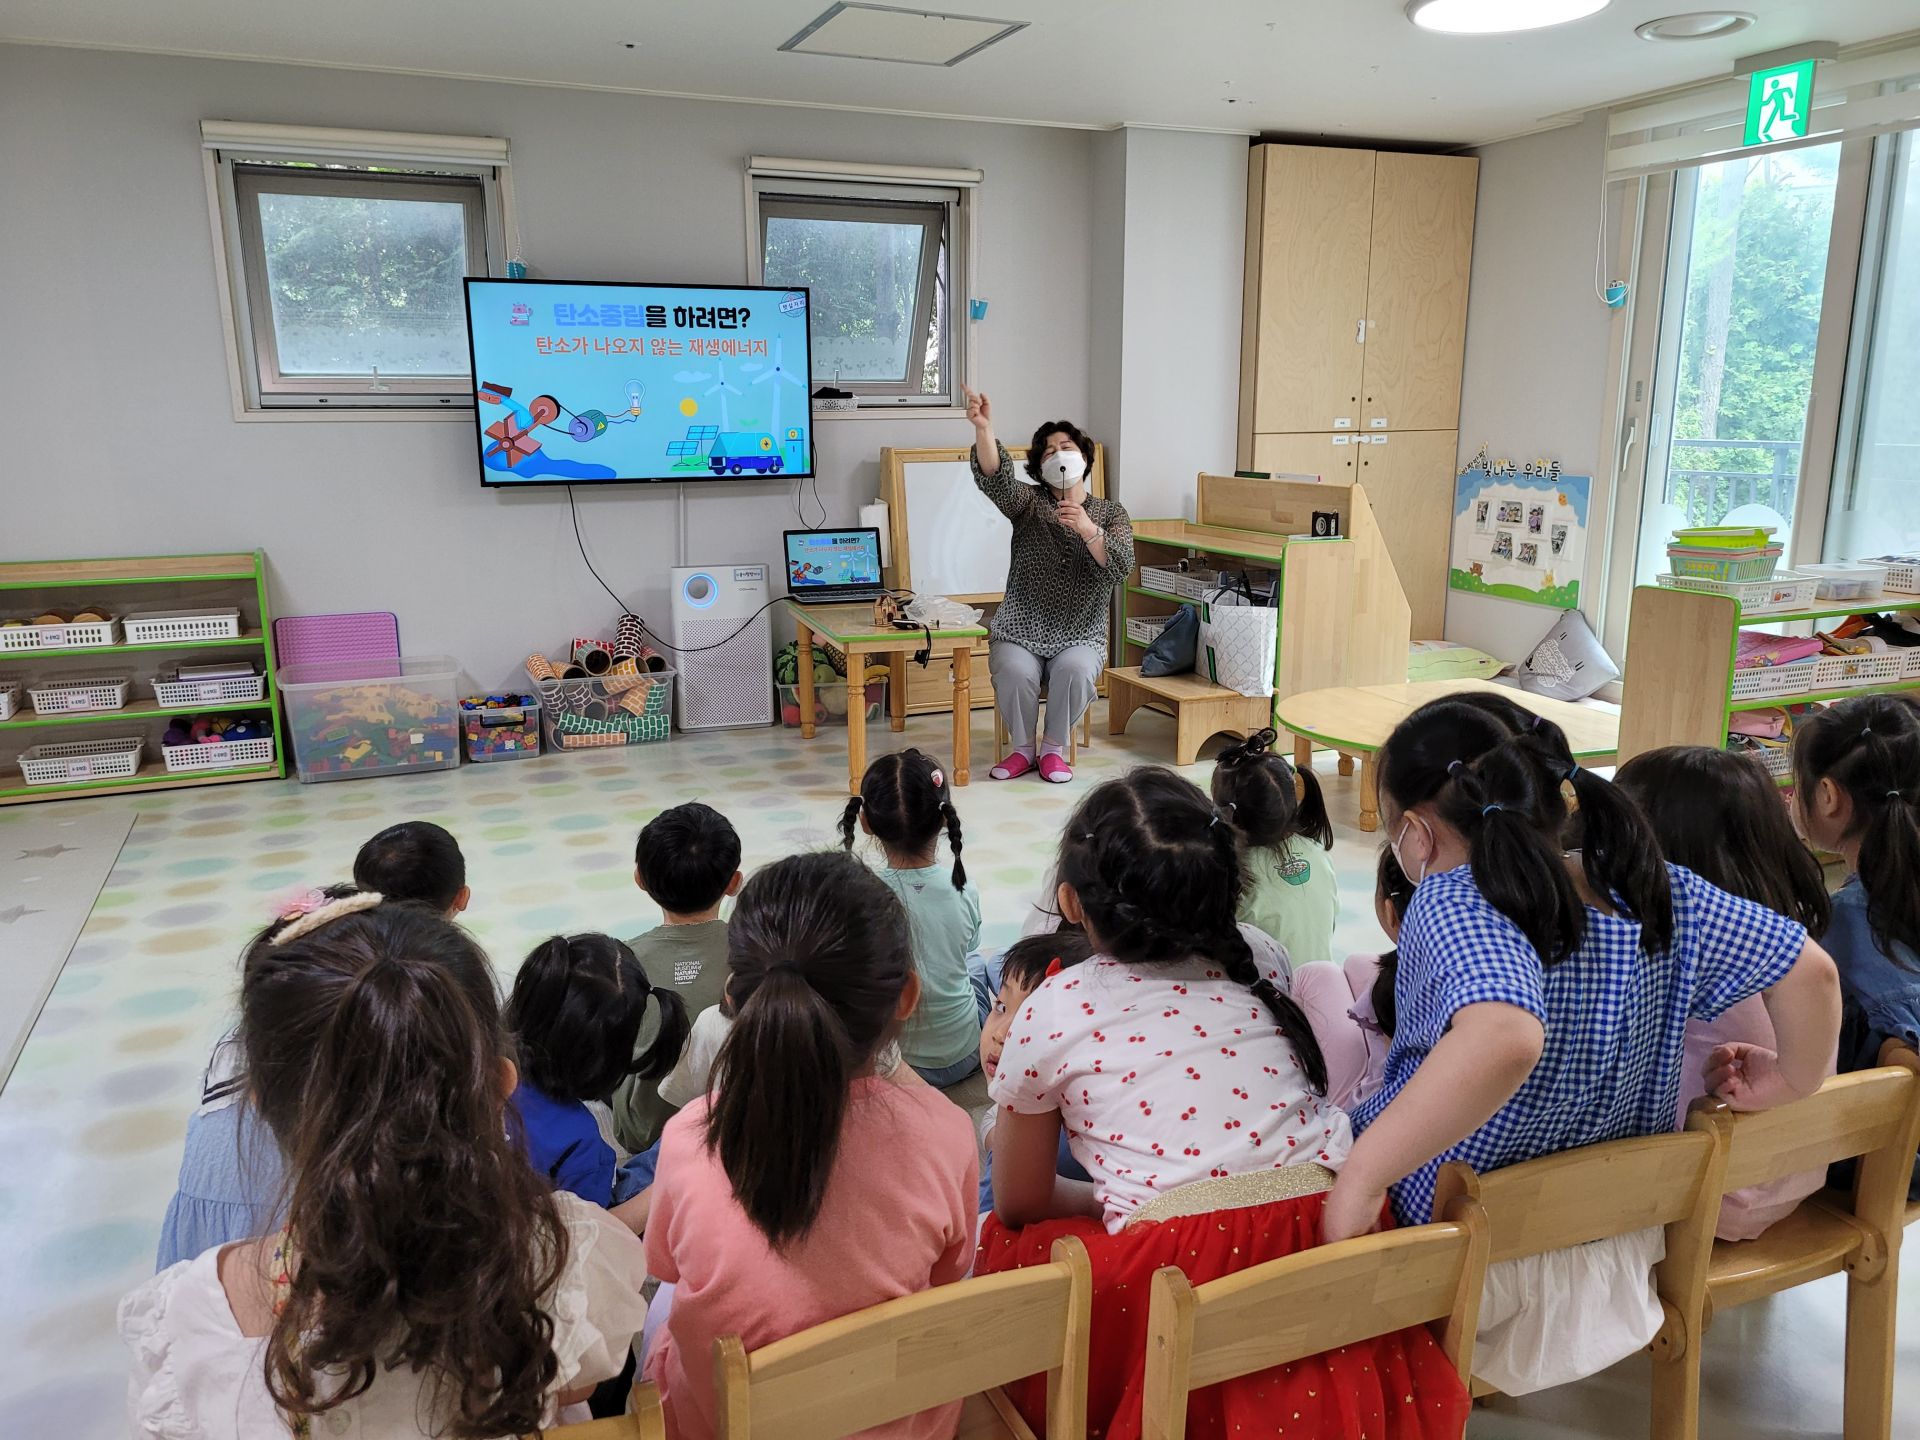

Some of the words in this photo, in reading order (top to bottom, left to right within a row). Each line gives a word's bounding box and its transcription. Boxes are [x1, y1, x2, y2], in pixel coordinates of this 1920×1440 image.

[553, 303, 667, 328] 탄소중립을
[673, 305, 751, 329] 하려면?
[536, 336, 588, 356] 탄소가
[594, 337, 644, 356] 나오지
[651, 338, 683, 356] 않는
[688, 339, 768, 357] 재생에너지
[1482, 460, 1517, 478] 빛나는
[1522, 461, 1560, 481] 우리들
